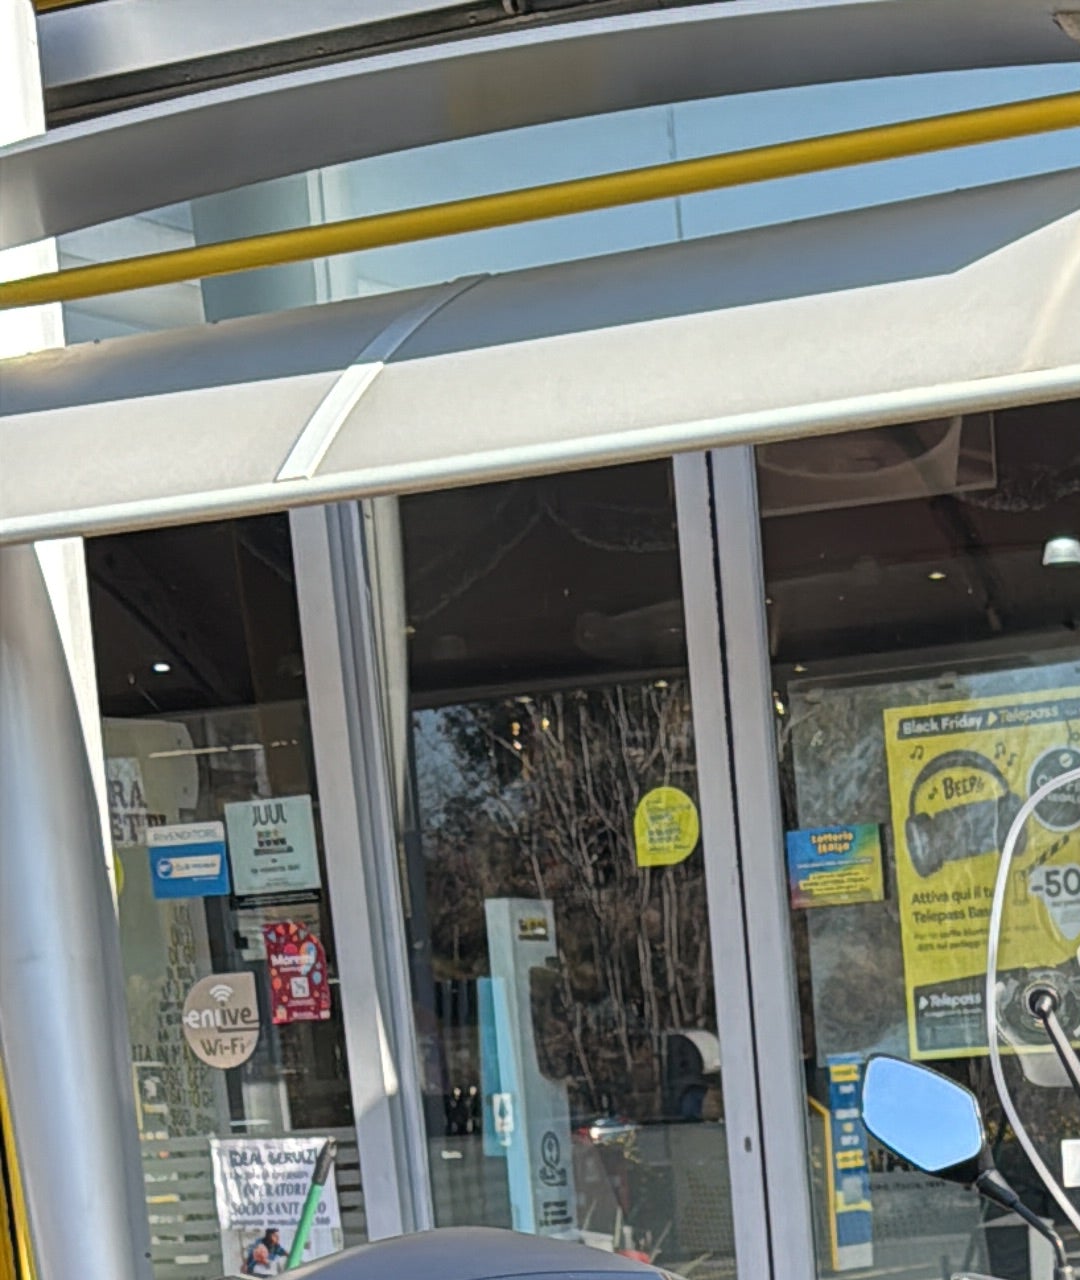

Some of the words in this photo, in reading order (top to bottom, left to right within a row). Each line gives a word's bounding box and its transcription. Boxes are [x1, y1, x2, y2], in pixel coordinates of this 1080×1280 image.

[902, 717, 939, 735] Black
[941, 714, 983, 730] Friday
[999, 706, 1059, 723] Telepass
[253, 803, 288, 827] JUUL
[912, 889, 949, 905] Attiva
[951, 887, 972, 904] qui
[912, 909, 966, 925] Telepass
[200, 1037, 246, 1057] Wi-Fi
